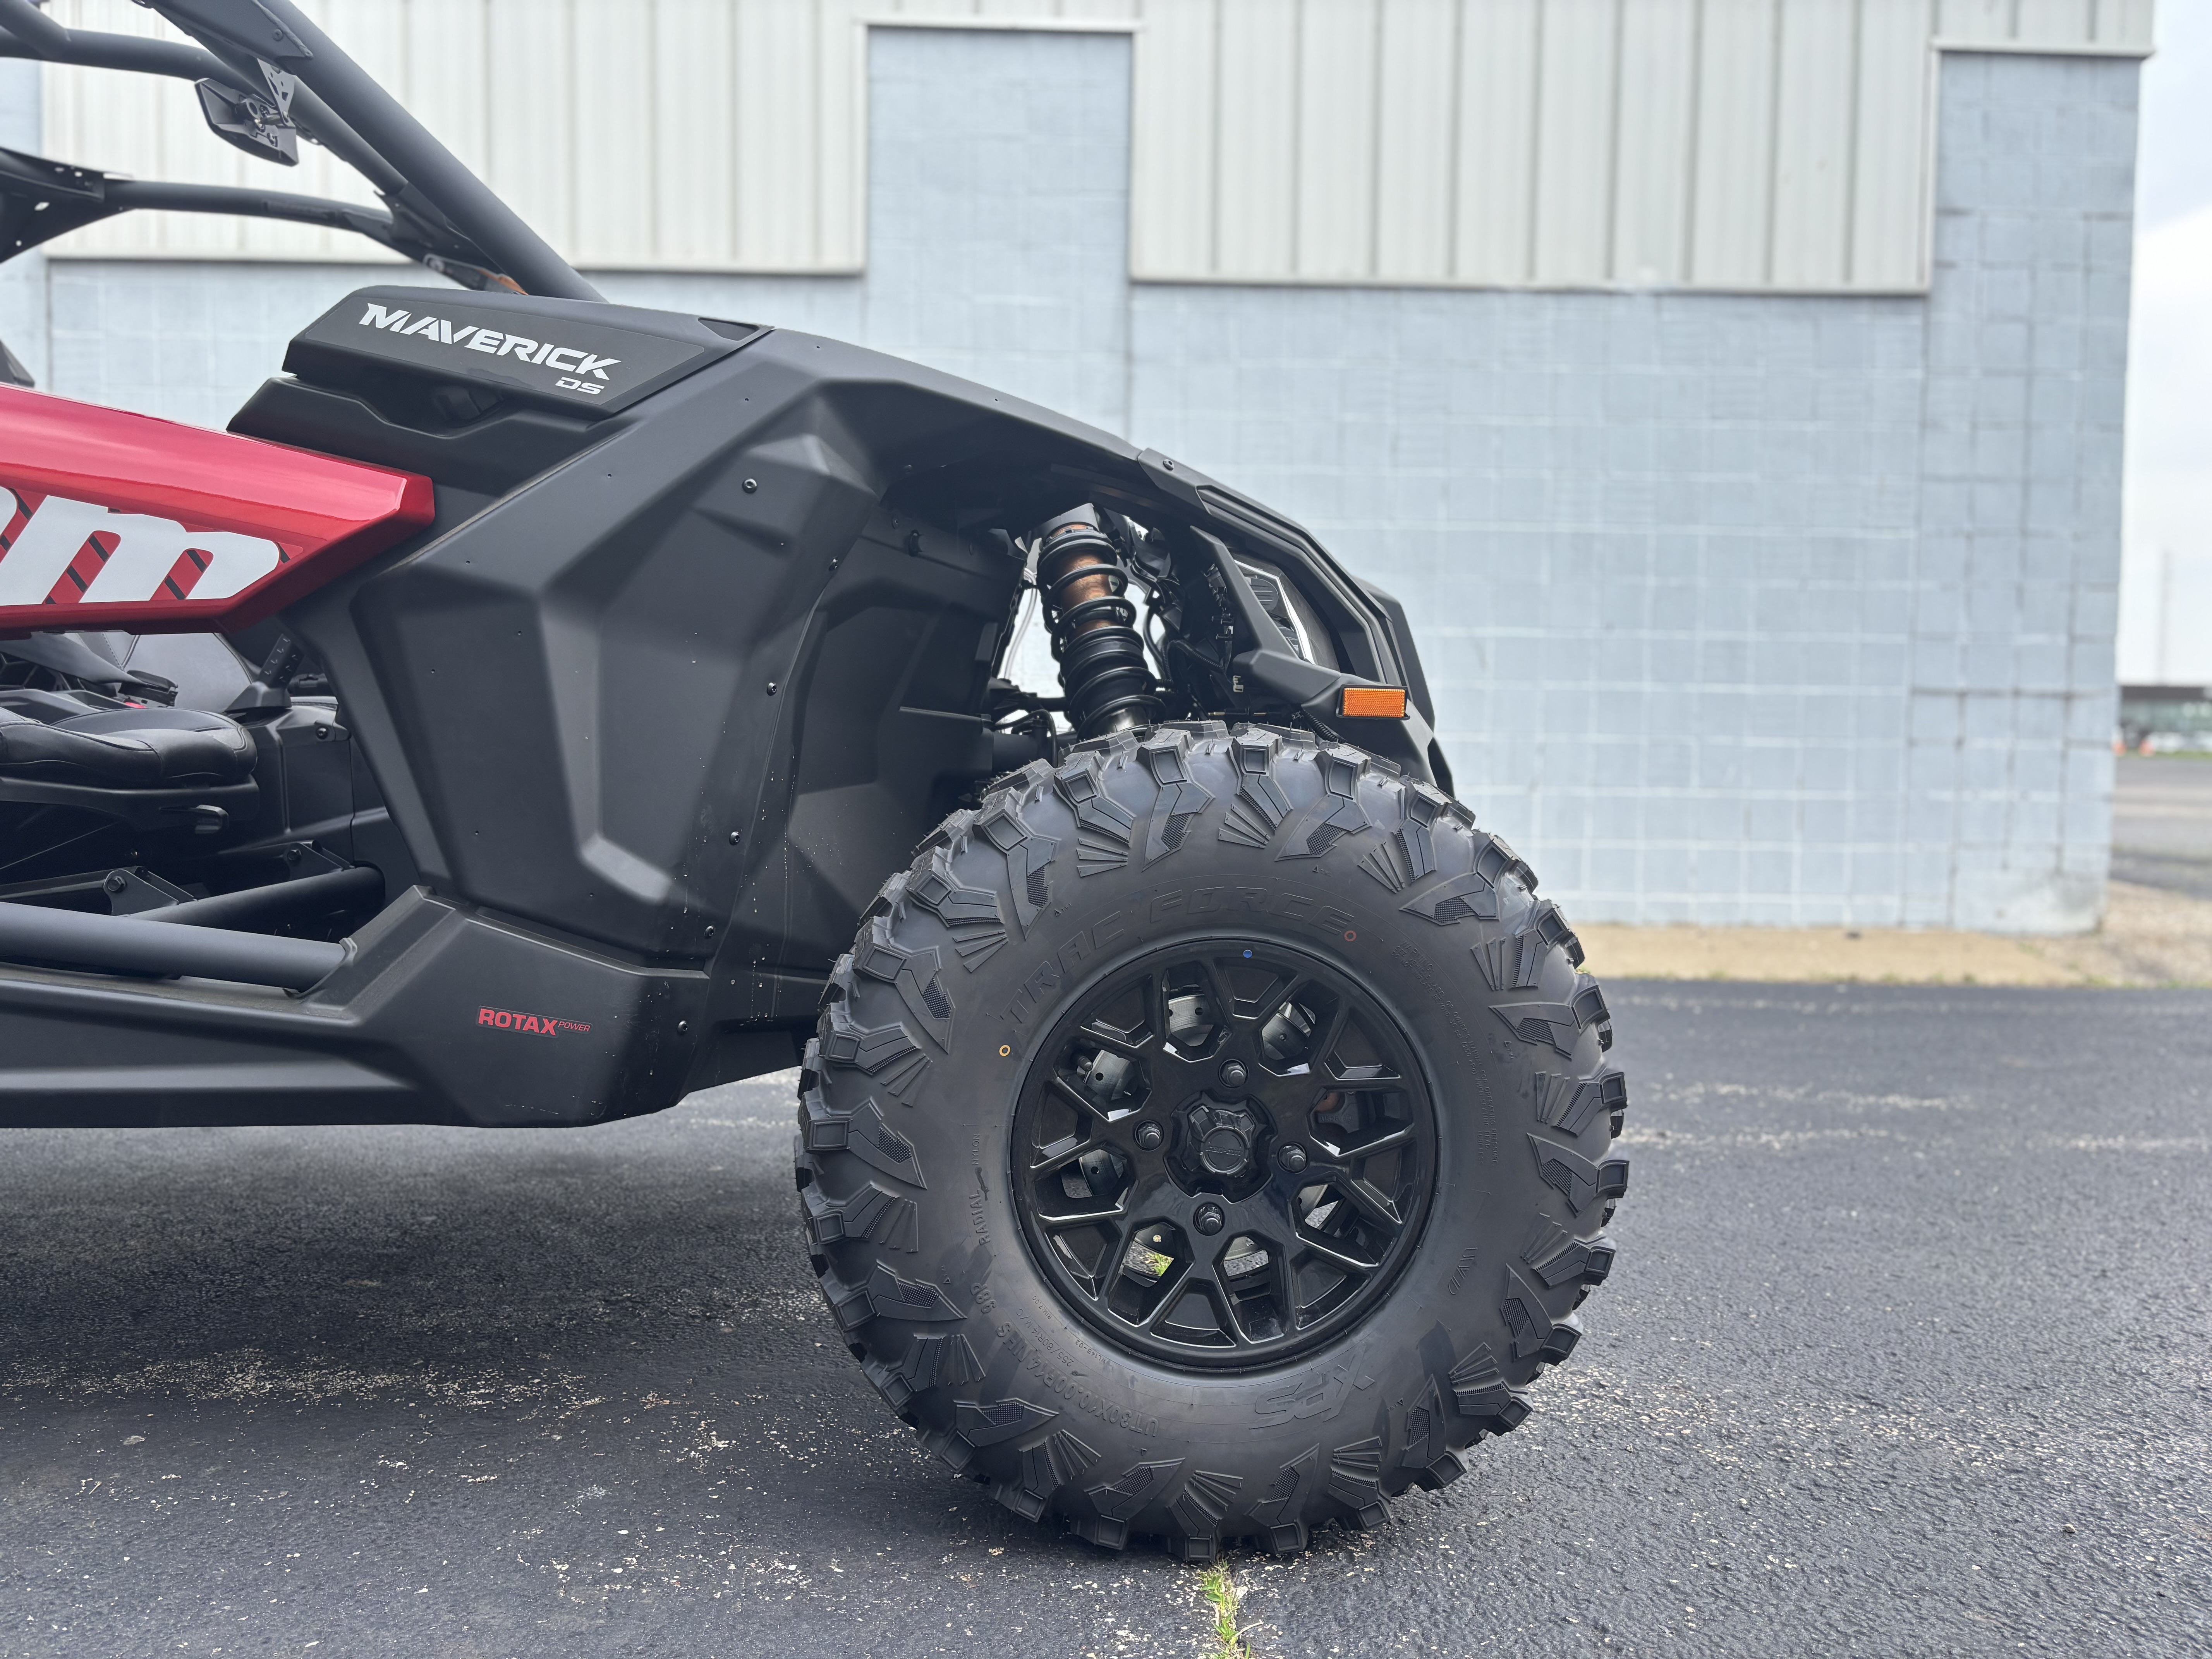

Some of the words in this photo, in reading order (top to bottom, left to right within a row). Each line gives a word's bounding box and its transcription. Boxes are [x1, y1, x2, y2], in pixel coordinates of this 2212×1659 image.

[359, 303, 621, 380] MAVERICK
[555, 377, 605, 395] DS
[0, 486, 280, 606] m
[999, 910, 1125, 1024] TRAC
[1150, 886, 1355, 936] FORCE
[478, 1008, 558, 1036] ROTAX
[558, 1021, 591, 1032] POWER
[971, 1133, 981, 1166] NYLON
[969, 1190, 991, 1246] RADIAL
[969, 1282, 996, 1315] 98P
[1016, 1309, 1034, 1328] M/C
[995, 1321, 1033, 1363] NHS
[1031, 1328, 1075, 1367] 255/80R14
[1026, 1355, 1159, 1437] UT30X10.00R14
[1248, 1345, 1376, 1430] XPS
